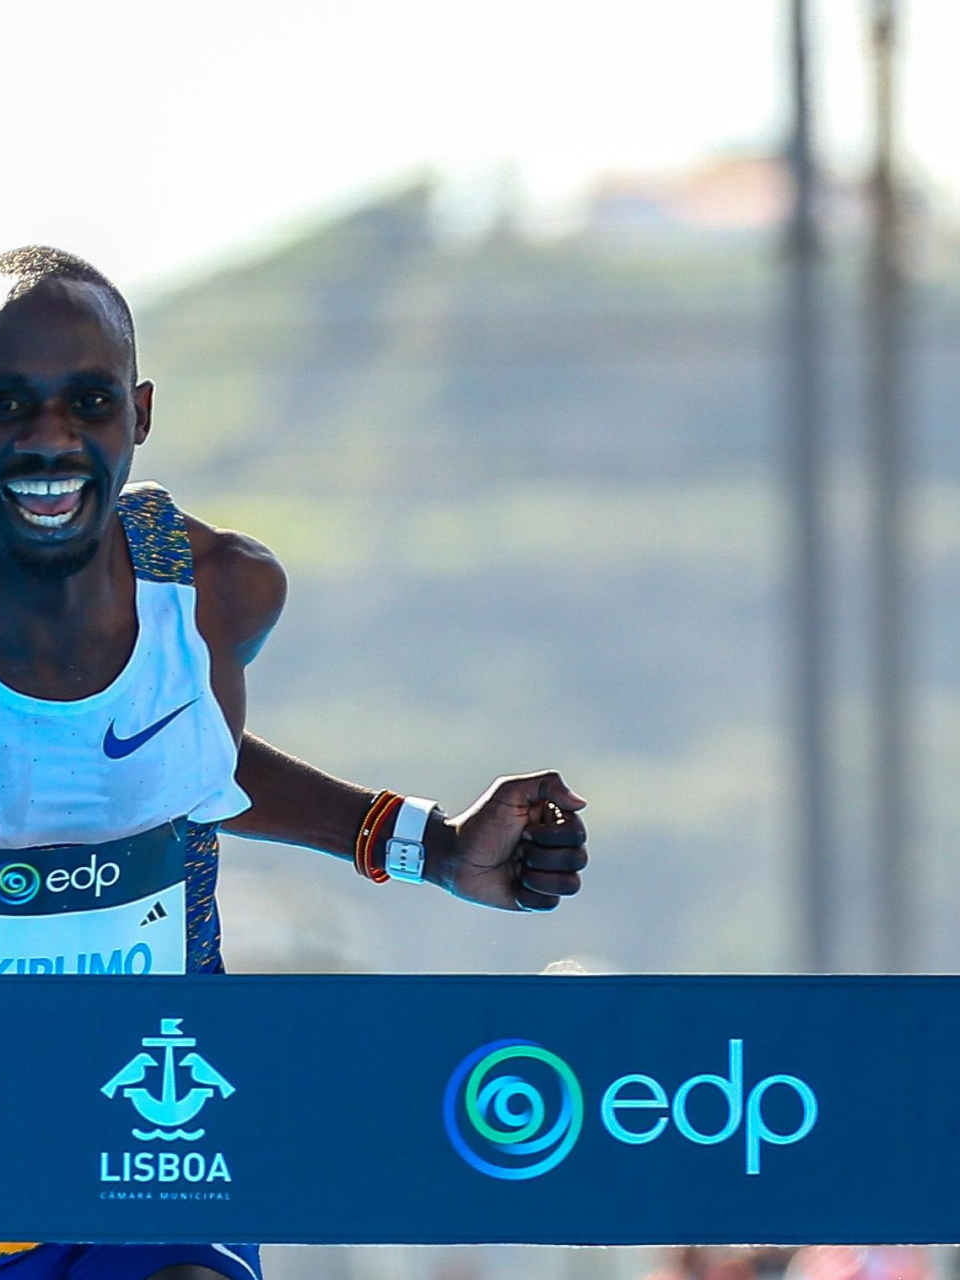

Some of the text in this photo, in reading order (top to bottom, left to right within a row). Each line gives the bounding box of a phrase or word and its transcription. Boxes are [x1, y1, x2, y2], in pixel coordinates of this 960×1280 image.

[45, 853, 120, 897] edp
[600, 1038, 818, 1175] edp
[100, 1152, 232, 1182] LISBOA
[159, 1192, 231, 1201] MUNICIPAL
